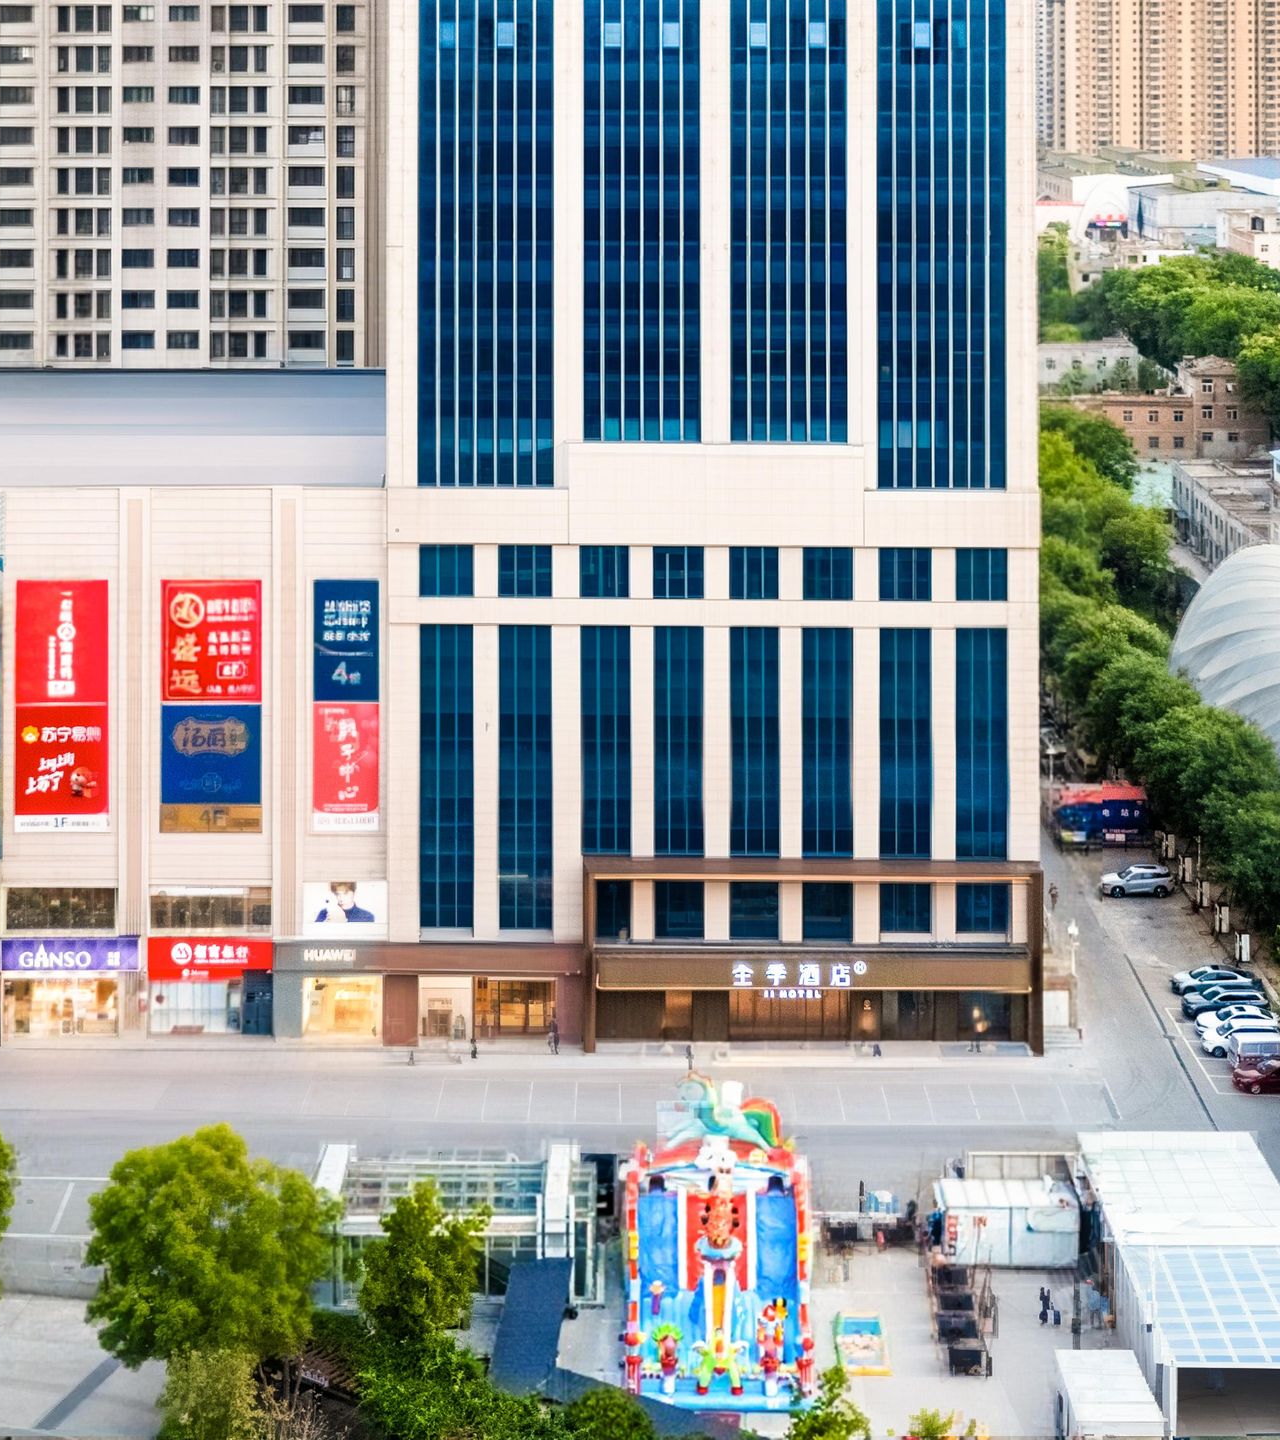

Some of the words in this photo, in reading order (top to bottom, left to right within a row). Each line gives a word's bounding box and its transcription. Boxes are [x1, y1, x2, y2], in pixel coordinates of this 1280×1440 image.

[41, 726, 101, 742] 苏宁易购
[18, 944, 91, 968] GANSO
[303, 949, 357, 961] HUAWEI
[732, 963, 851, 986] 全季酒店
[779, 989, 822, 998] HOTEL
